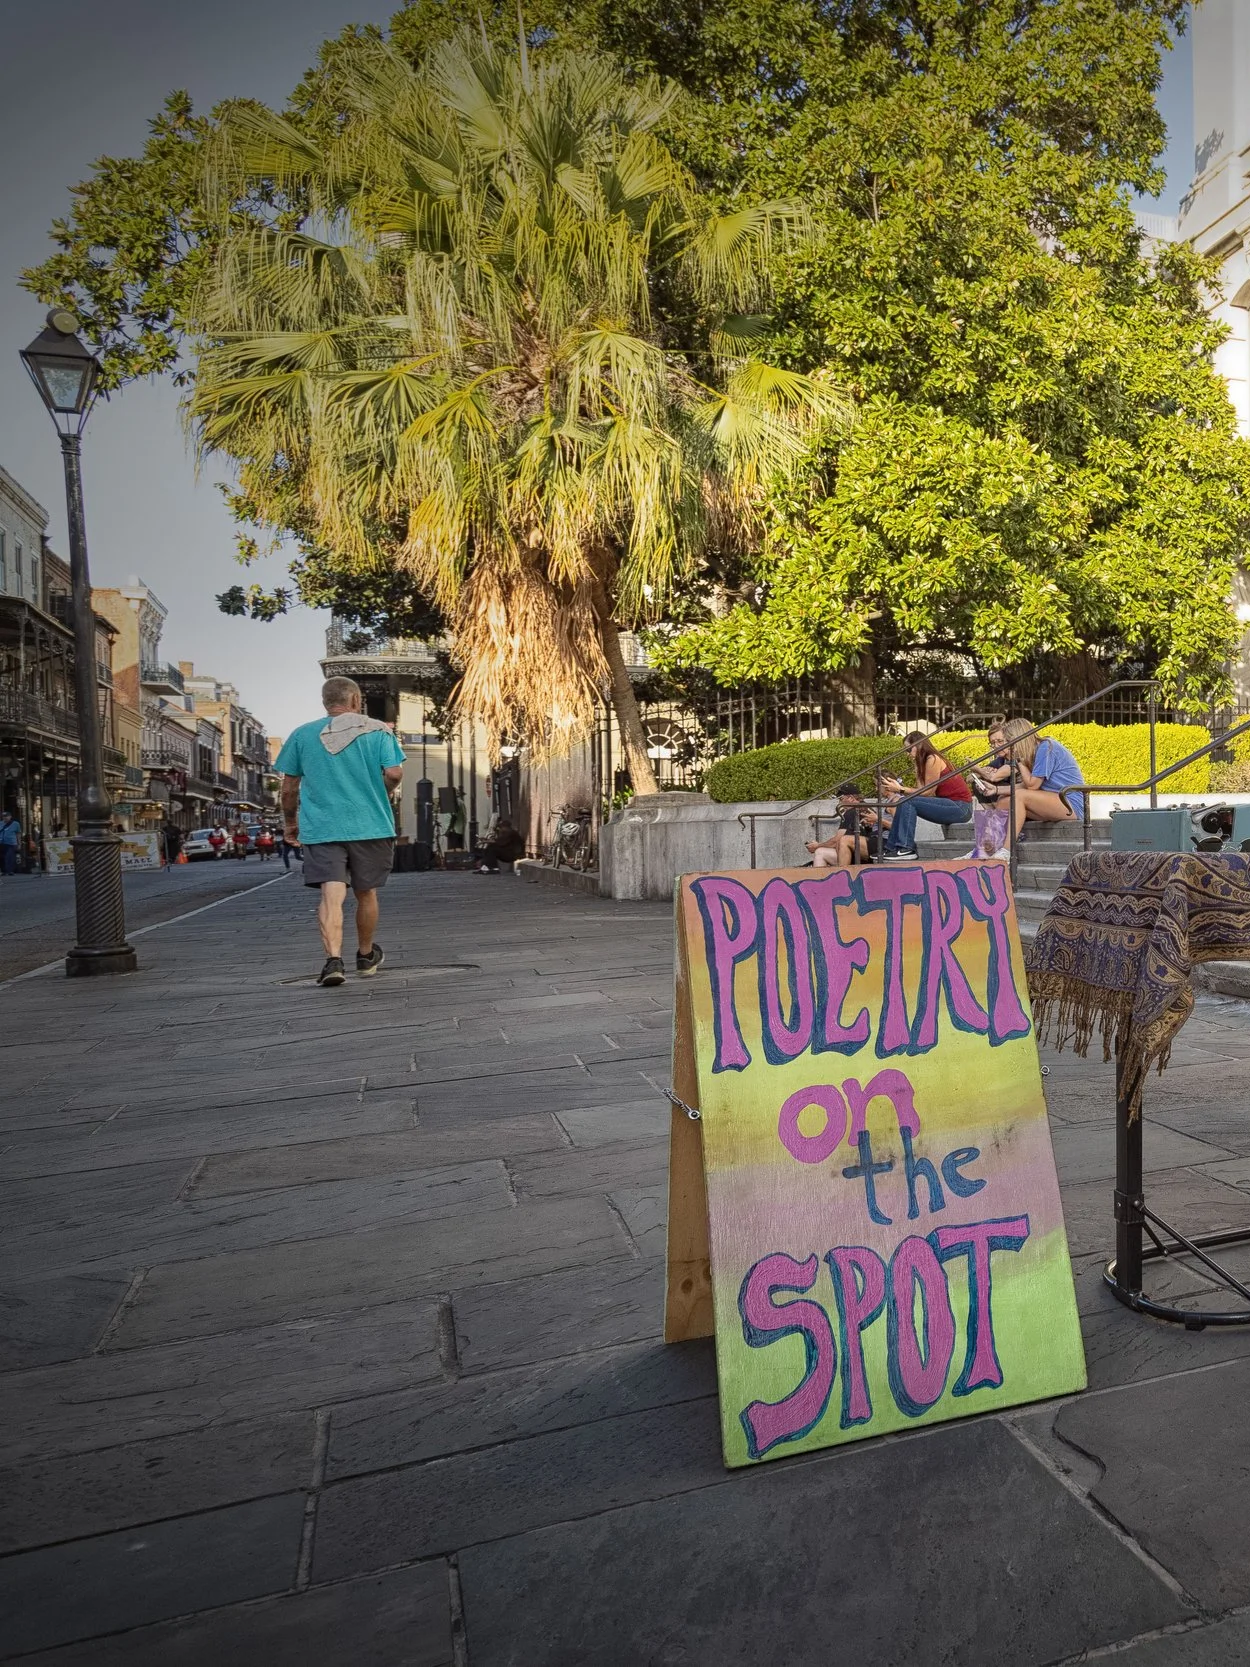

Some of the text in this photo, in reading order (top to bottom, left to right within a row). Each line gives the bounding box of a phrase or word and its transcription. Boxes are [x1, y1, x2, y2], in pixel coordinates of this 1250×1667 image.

[691, 867, 1031, 1074] POETRY
[778, 1069, 920, 1163] on
[842, 1125, 986, 1225] the
[738, 1214, 1029, 1459] SPOT
